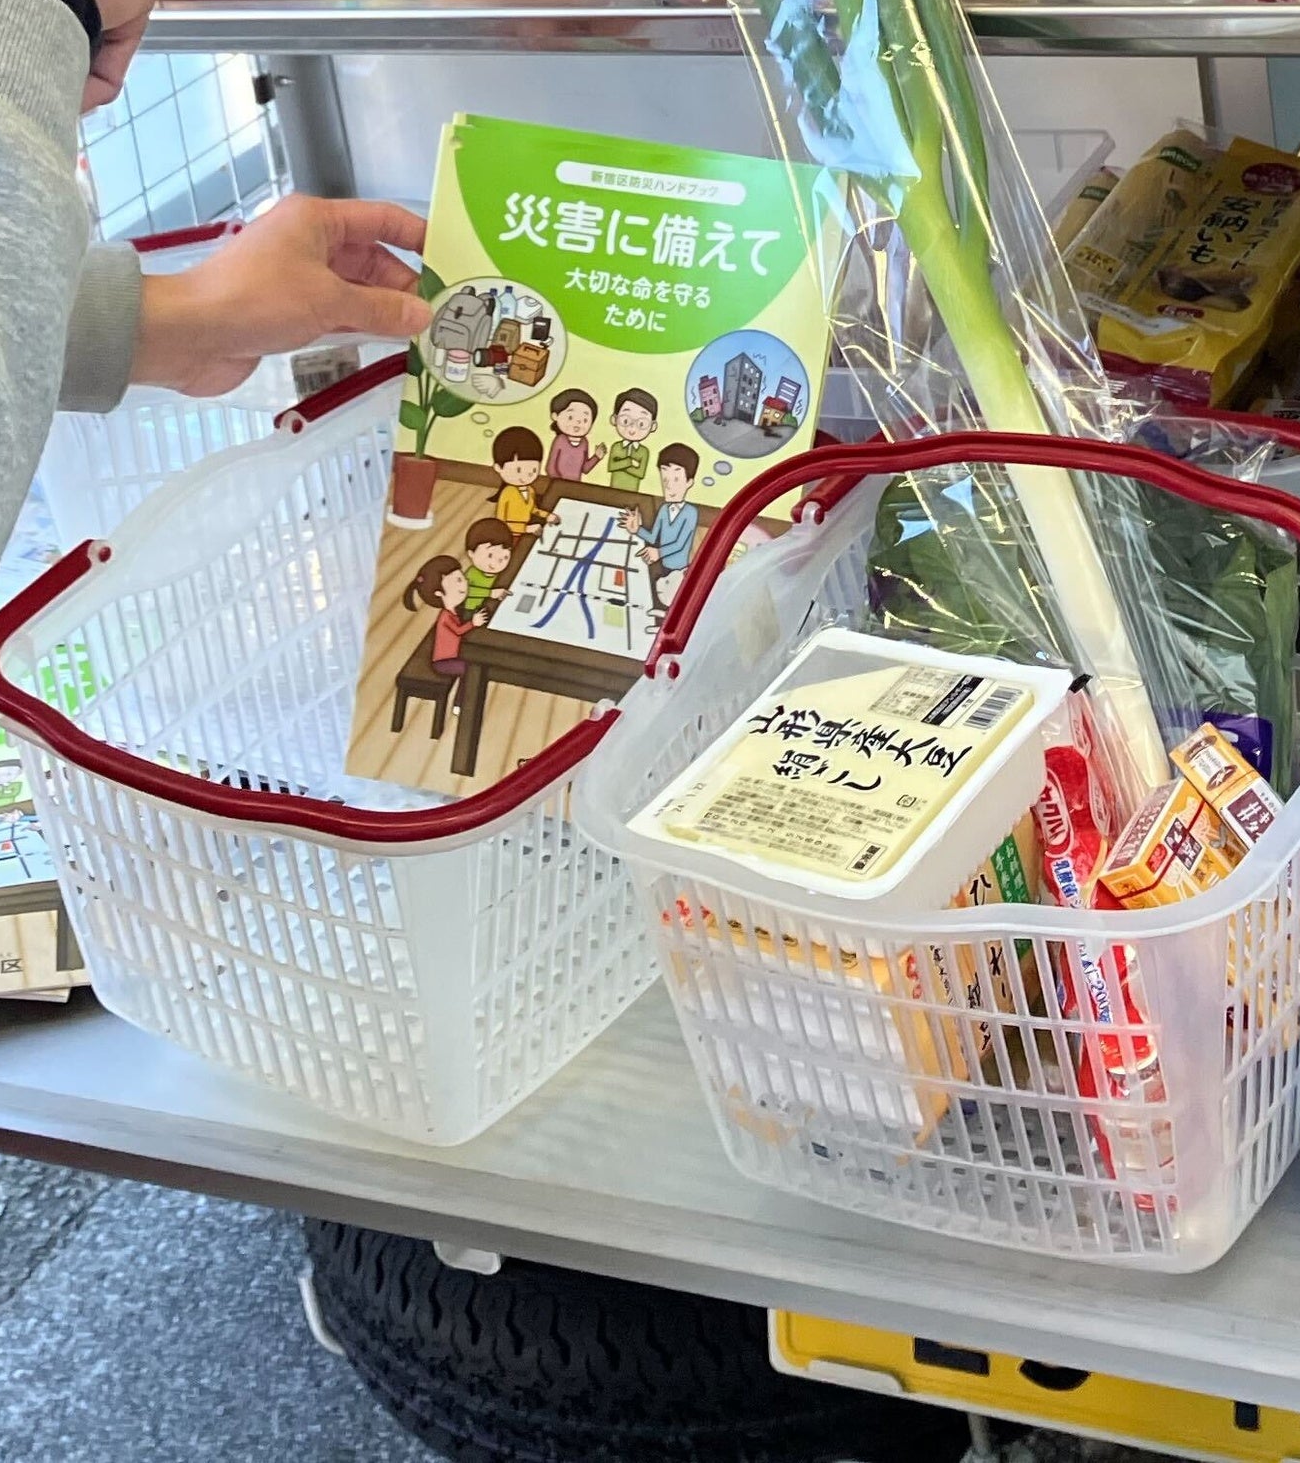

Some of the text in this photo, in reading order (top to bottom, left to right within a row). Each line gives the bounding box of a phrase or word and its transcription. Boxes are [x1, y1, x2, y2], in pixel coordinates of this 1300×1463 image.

[590, 169, 719, 198] 新宿区防災ハンドブック
[498, 191, 781, 277] 災害に備えて
[564, 266, 712, 309] 大切な命を守る
[603, 304, 667, 333] ために
[747, 704, 974, 779] 山形県産大豆
[771, 748, 883, 793] 絹ごし
